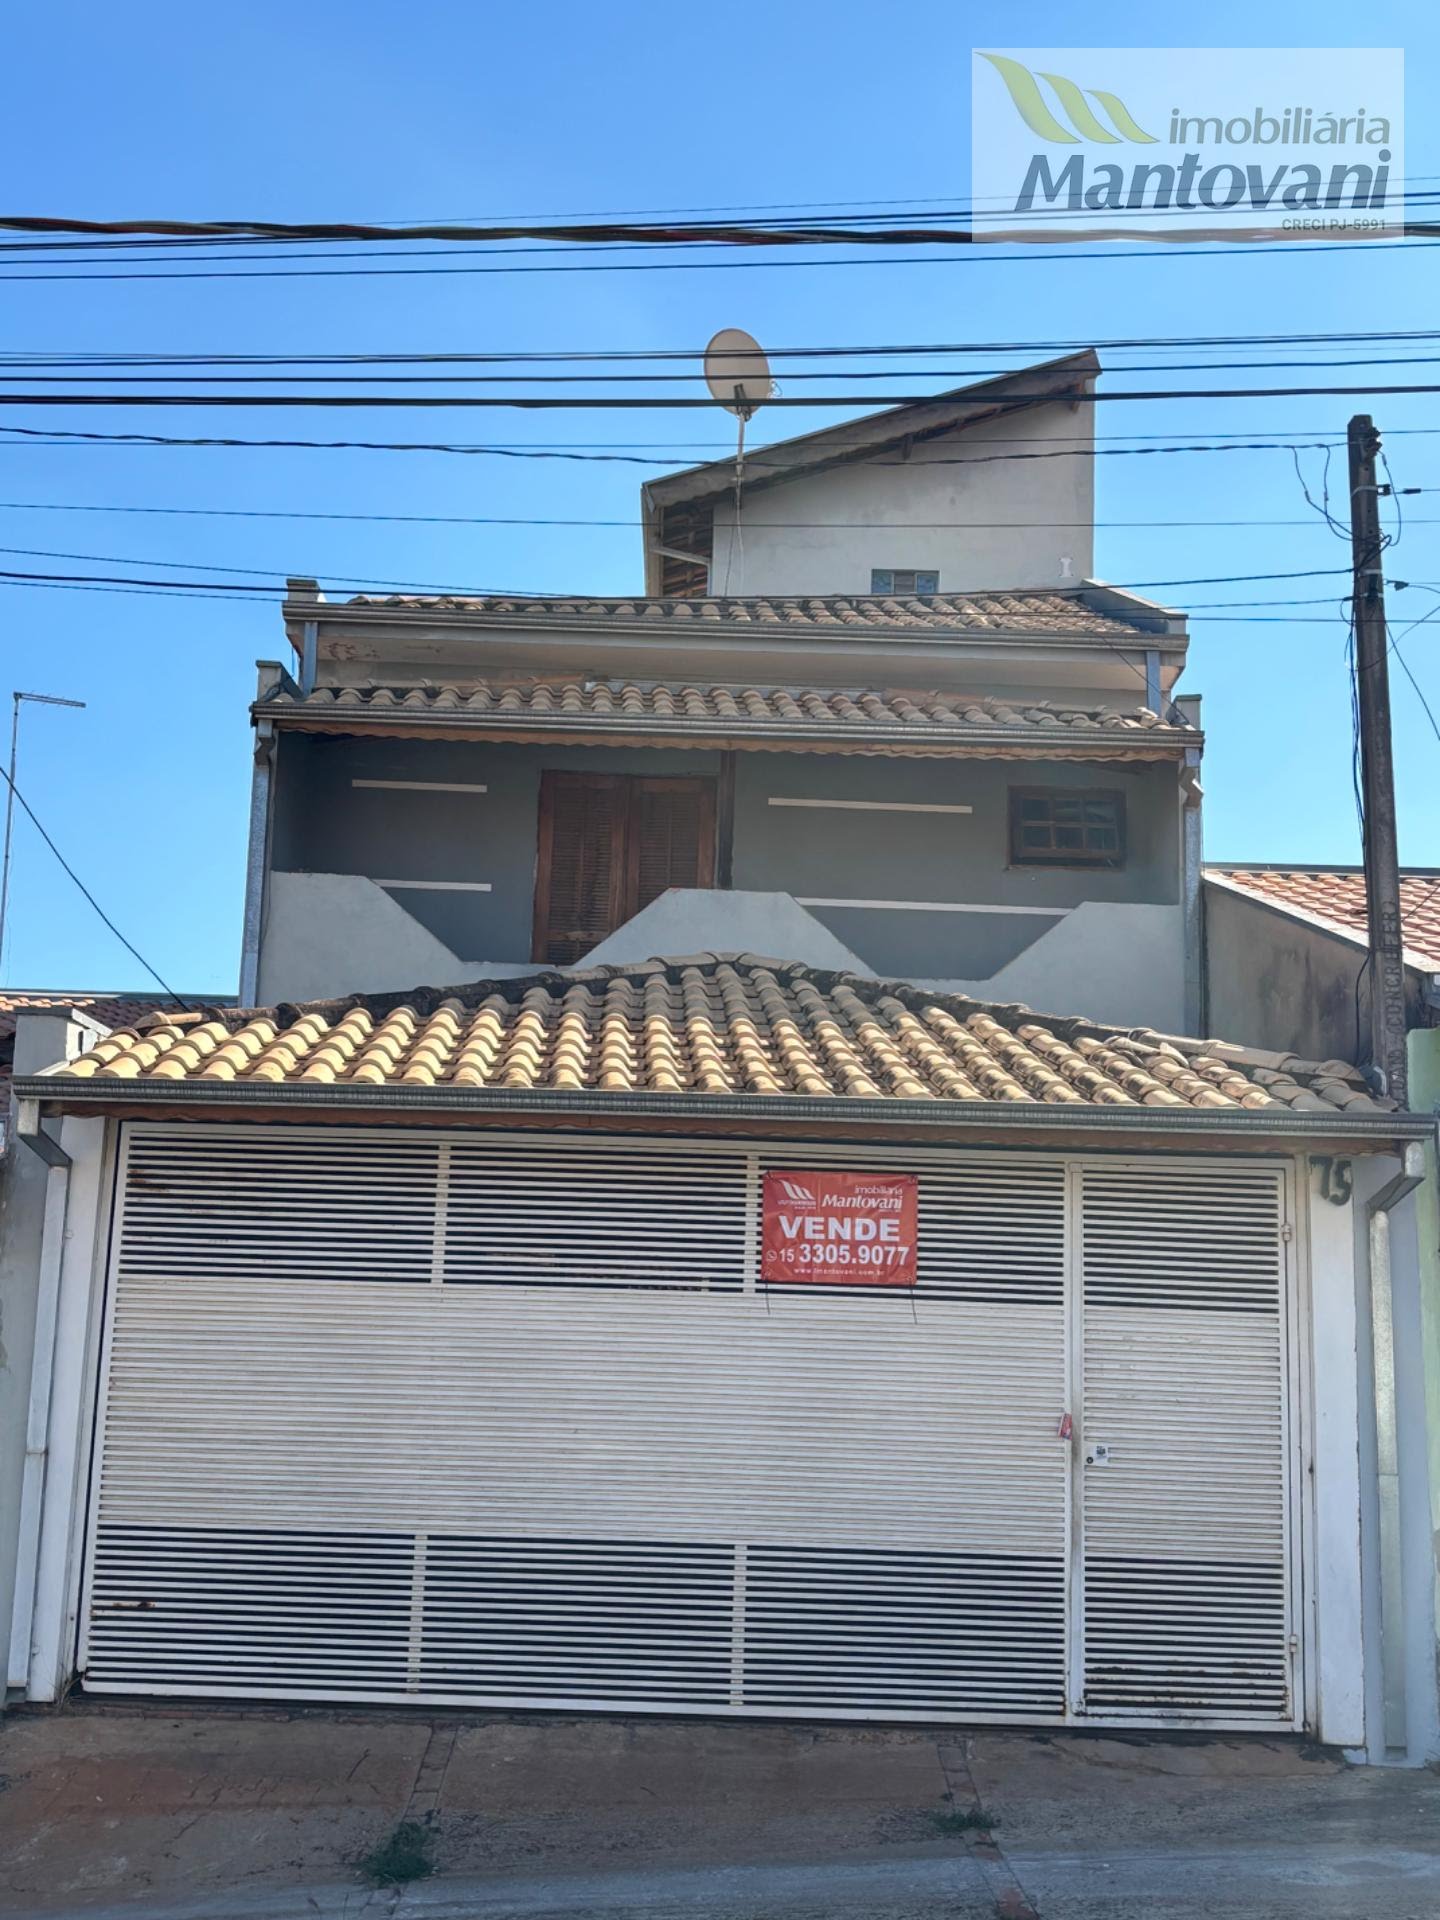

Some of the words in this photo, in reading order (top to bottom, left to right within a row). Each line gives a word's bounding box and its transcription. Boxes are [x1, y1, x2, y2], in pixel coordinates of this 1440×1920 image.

[1309, 1155, 1352, 1206] 75
[821, 1194, 903, 1210] Mantovani
[778, 1215, 900, 1242] VENDE
[779, 1249, 795, 1263] 15
[799, 1243, 910, 1265] 3305.9077
